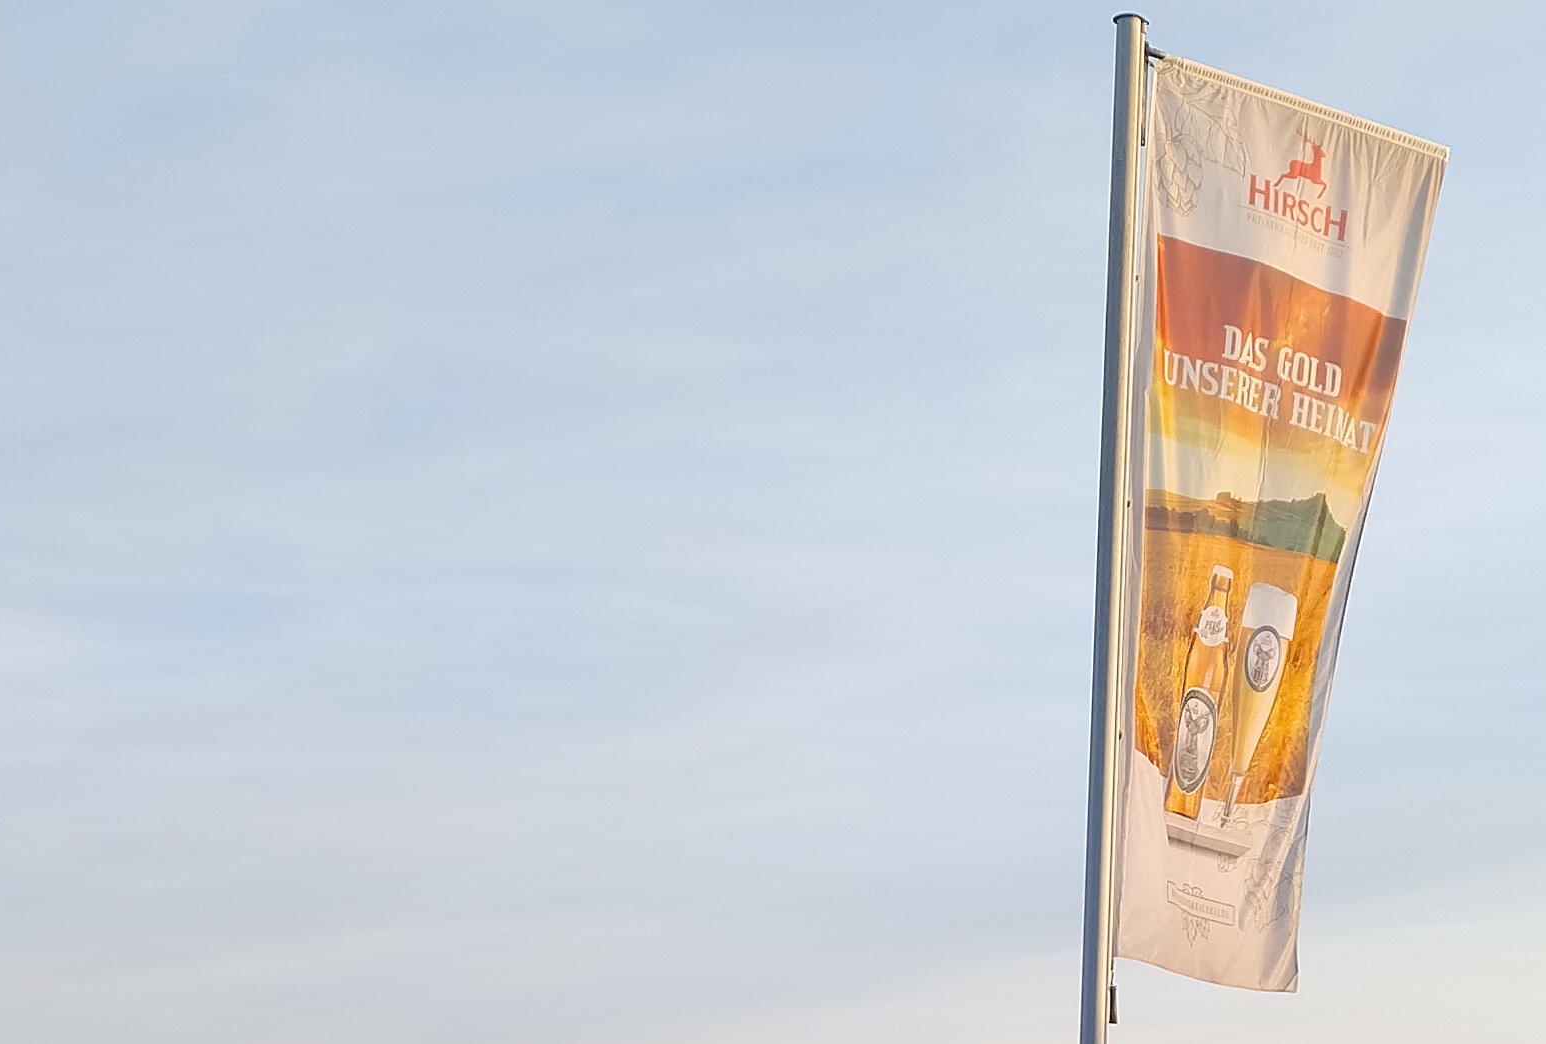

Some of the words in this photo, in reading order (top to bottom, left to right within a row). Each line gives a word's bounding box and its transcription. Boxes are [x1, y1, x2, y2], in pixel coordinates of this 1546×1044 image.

[1249, 173, 1348, 242] HIRSCH
[1164, 349, 1282, 419] UNSERER
[1222, 324, 1269, 372] DAS
[1277, 347, 1342, 398] GOLD
